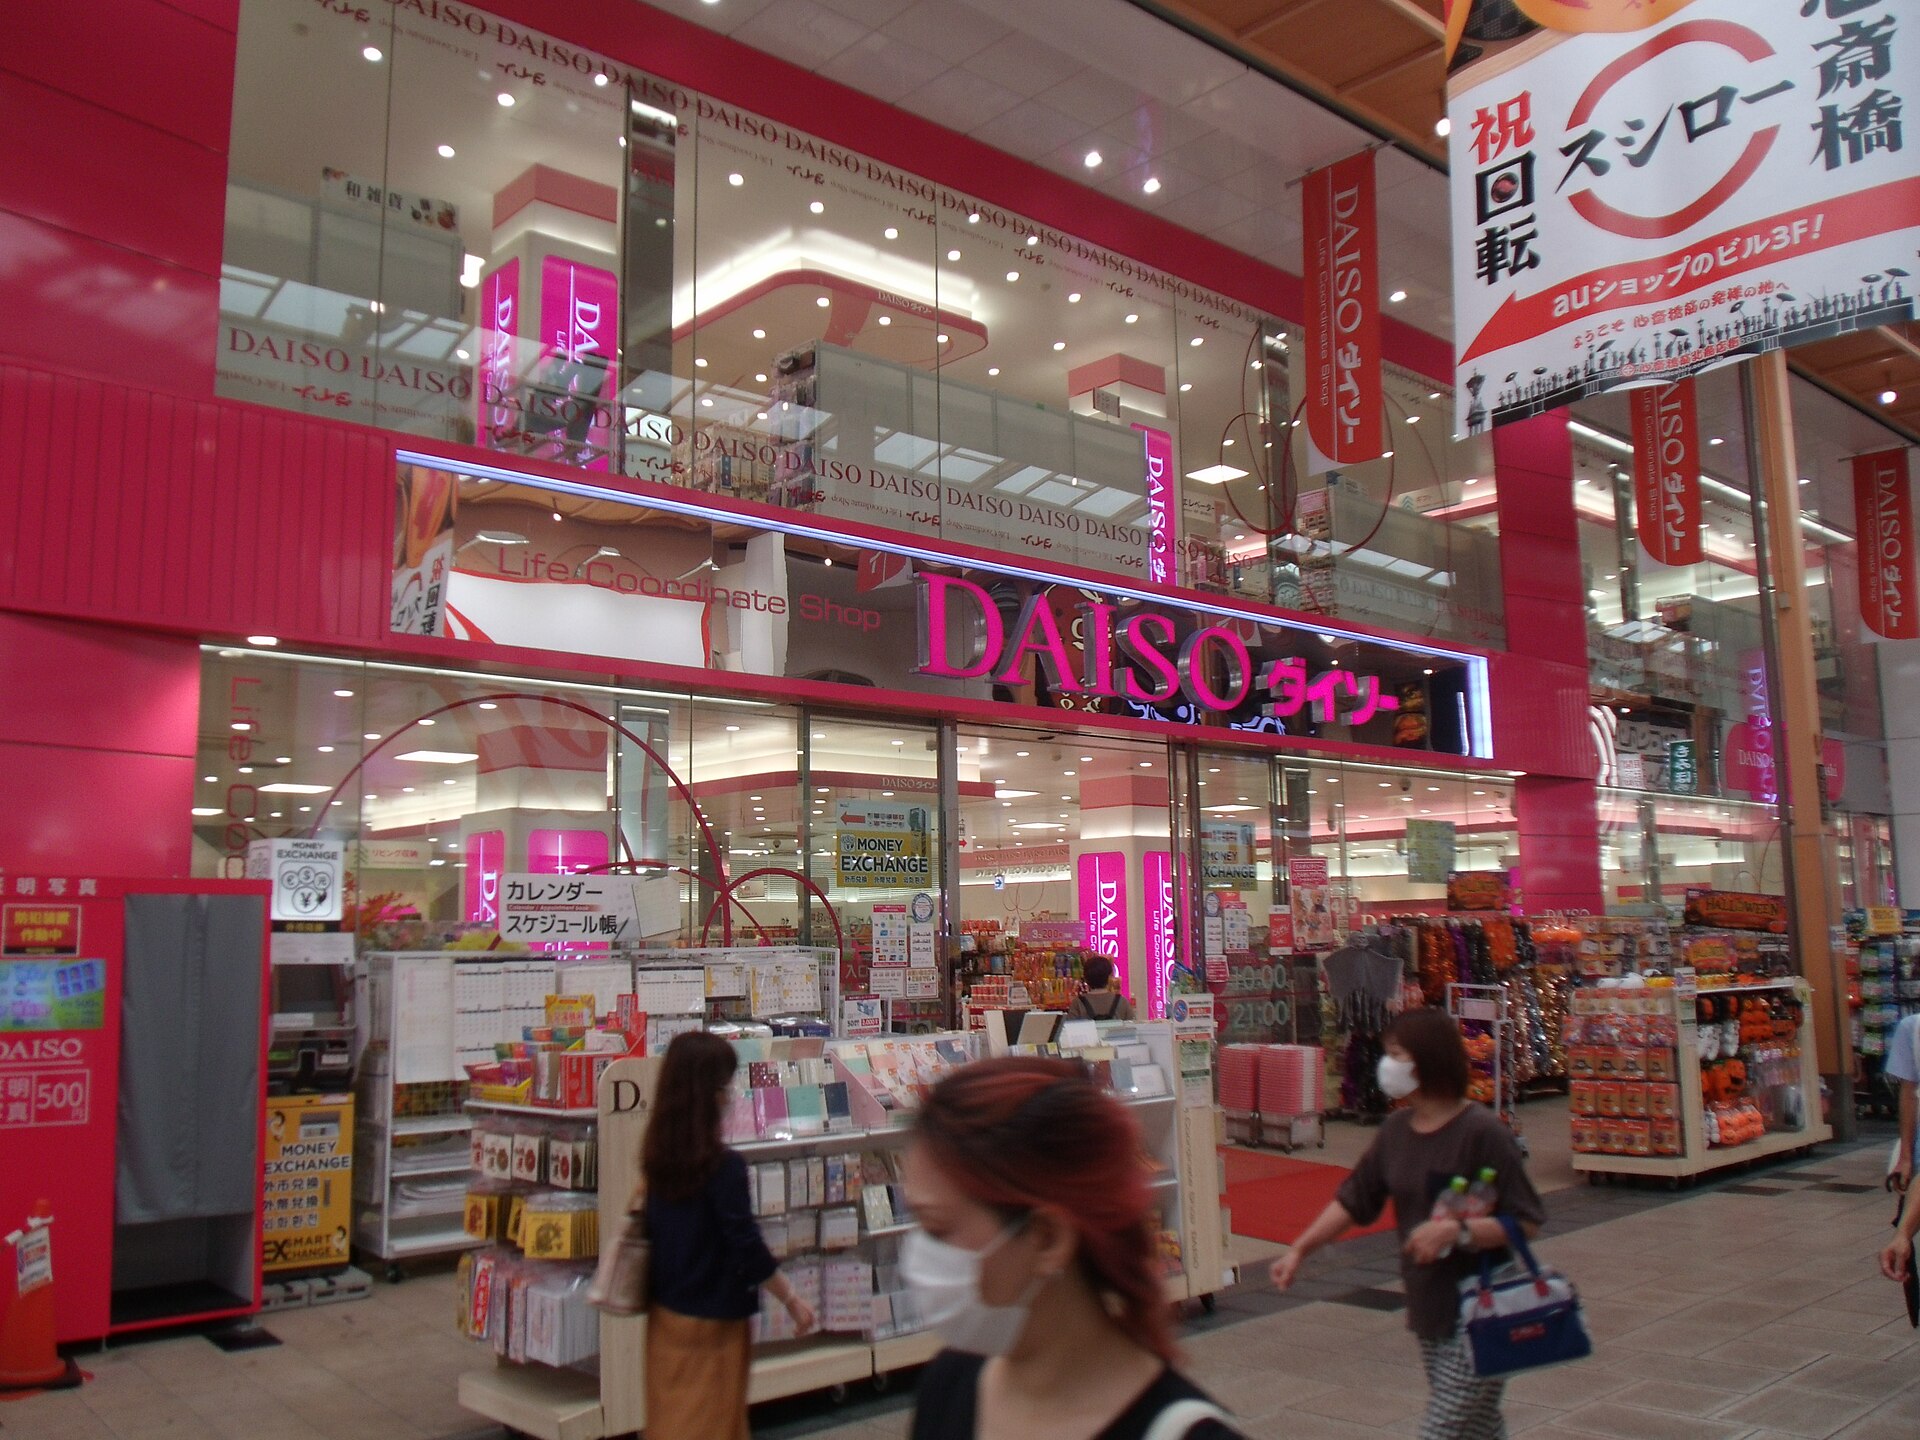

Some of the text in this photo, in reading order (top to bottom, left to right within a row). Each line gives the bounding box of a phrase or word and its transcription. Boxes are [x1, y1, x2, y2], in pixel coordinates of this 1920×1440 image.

[495, 22, 593, 77] DAISO
[697, 98, 778, 144] DAISO
[785, 125, 861, 175] DAISO
[867, 154, 936, 202] DAISO
[942, 190, 1007, 230] DAISO
[1012, 217, 1073, 254] DAISO
[1077, 242, 1133, 277] DAISO
[1137, 264, 1189, 299] DAISO
[1555, 79, 1797, 195] スシロー
[1469, 89, 1542, 287] 祝回転
[1551, 213, 1825, 319] auショップのビル3F!
[1333, 184, 1363, 444] DAISO ダイソー
[1573, 317, 1626, 350] ようこそ
[229, 326, 349, 374] DAISO
[361, 355, 472, 400] DAISO
[693, 430, 777, 466] DAISO
[785, 449, 862, 485] DAISO
[869, 469, 940, 503] DAISO
[946, 486, 1014, 519] DAISO
[1019, 504, 1080, 533] DAISO
[1085, 518, 1142, 546] DAISO
[1658, 381, 1686, 552] AISO ダイソー
[1149, 453, 1166, 553] DAISO
[500, 547, 881, 633] Life Coordinate Shop
[1878, 468, 1903, 627] DAISO ダイソー
[913, 571, 1400, 726] DAISO ダイソー
[227, 676, 262, 763] Life
[0, 877, 97, 897] 明写真
[277, 849, 338, 861] EXCHANGE
[841, 856, 929, 873] EXCHANGE
[857, 838, 904, 852] MONEY
[1203, 865, 1256, 879] XCHANGE
[506, 913, 619, 936] スケジュール帳
[507, 880, 604, 902] カレンダー
[37, 1080, 84, 1110] 500
[264, 1156, 351, 1175] EXCHANGE
[281, 1141, 337, 1157] MONEY
